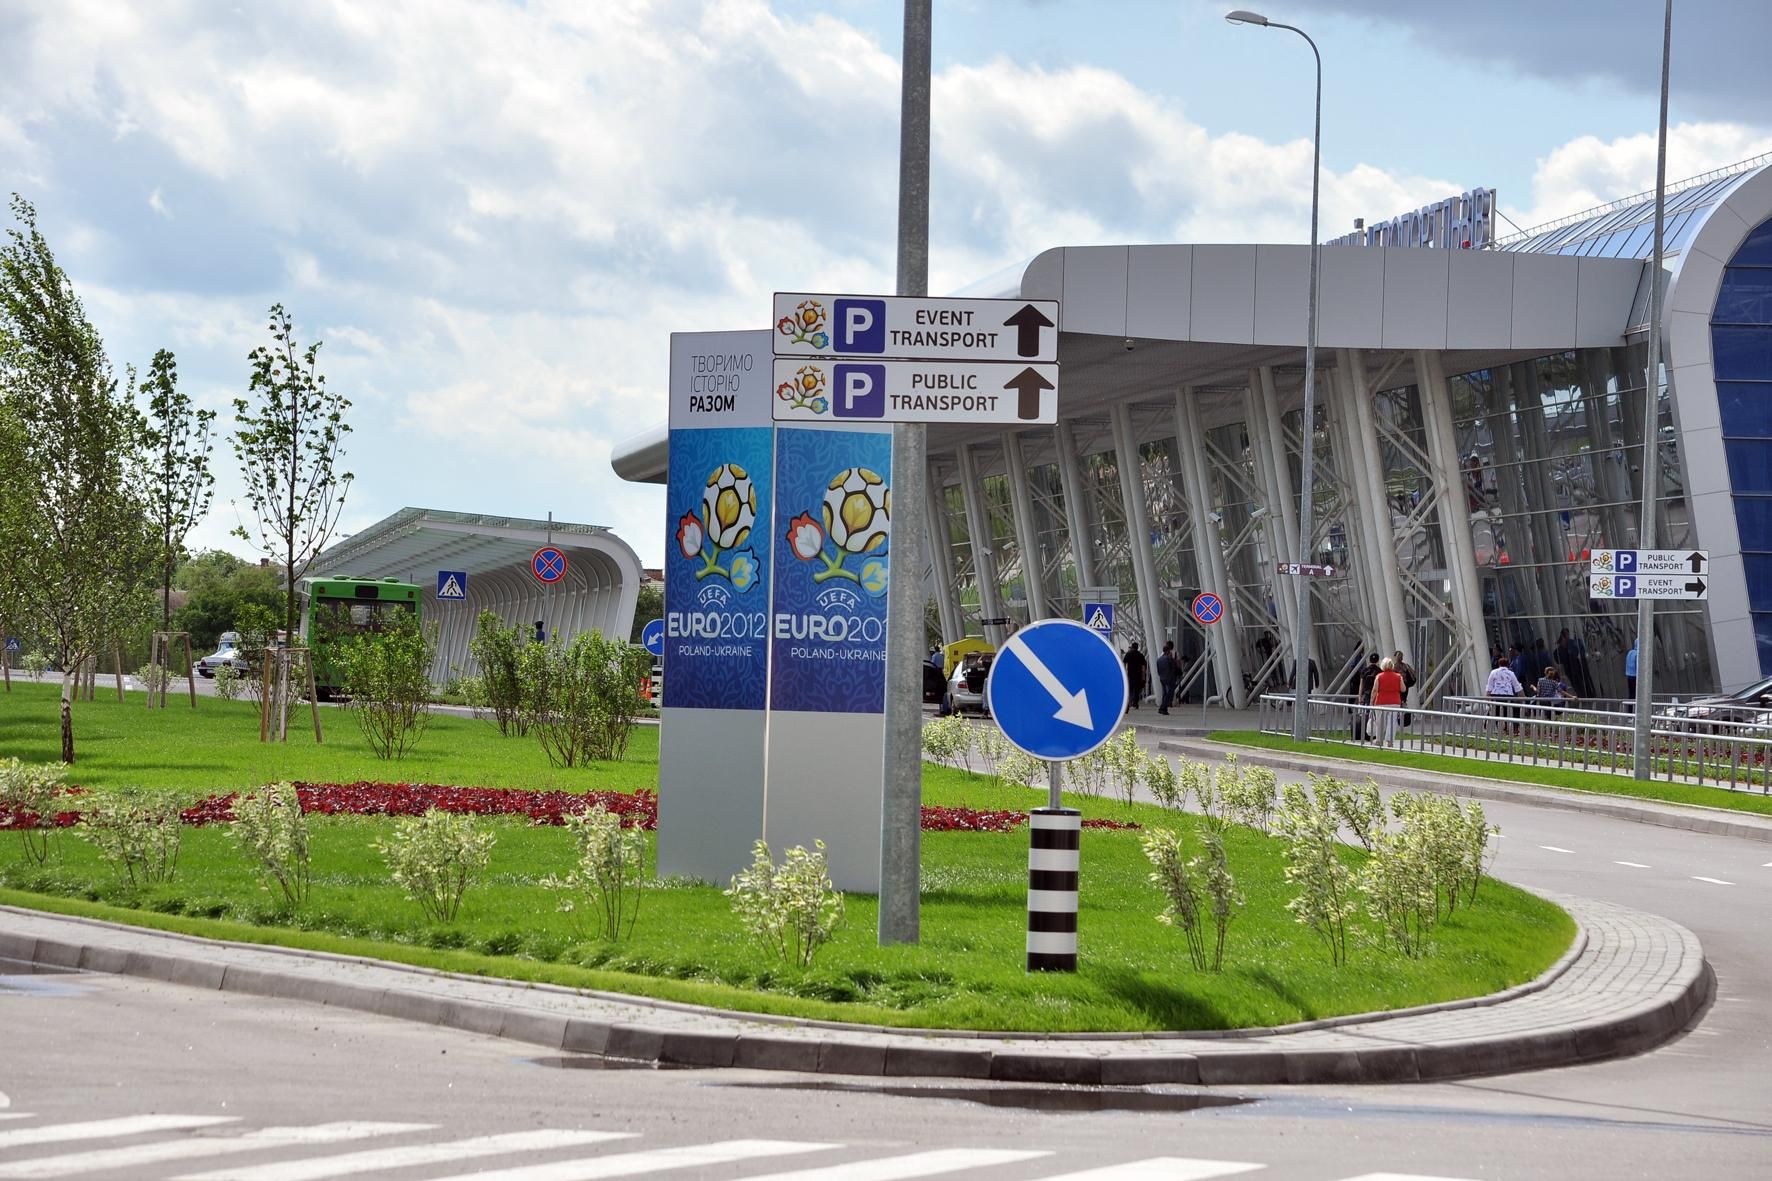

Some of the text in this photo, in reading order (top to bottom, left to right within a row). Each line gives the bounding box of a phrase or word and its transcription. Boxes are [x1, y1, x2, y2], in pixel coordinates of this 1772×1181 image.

[845, 307, 874, 345] P
[915, 310, 975, 326] EVENT
[890, 331, 998, 348] TRANSPORT
[691, 354, 753, 373] ТВОРИМО
[690, 374, 740, 392] ІСТОРІЮ
[912, 374, 977, 390] PUBLIC
[845, 372, 873, 409] P
[689, 395, 735, 412] РАЗОМ
[890, 396, 998, 412] TRANSPORT
[1620, 554, 1632, 569] P
[1619, 579, 1631, 594] P
[700, 590, 727, 604] UEFA
[819, 594, 855, 609] UEFA
[668, 612, 766, 638] EURO2012
[678, 645, 752, 657] POLAND-UKRAINE
[791, 647, 887, 661] POLAND-UKRAINE
